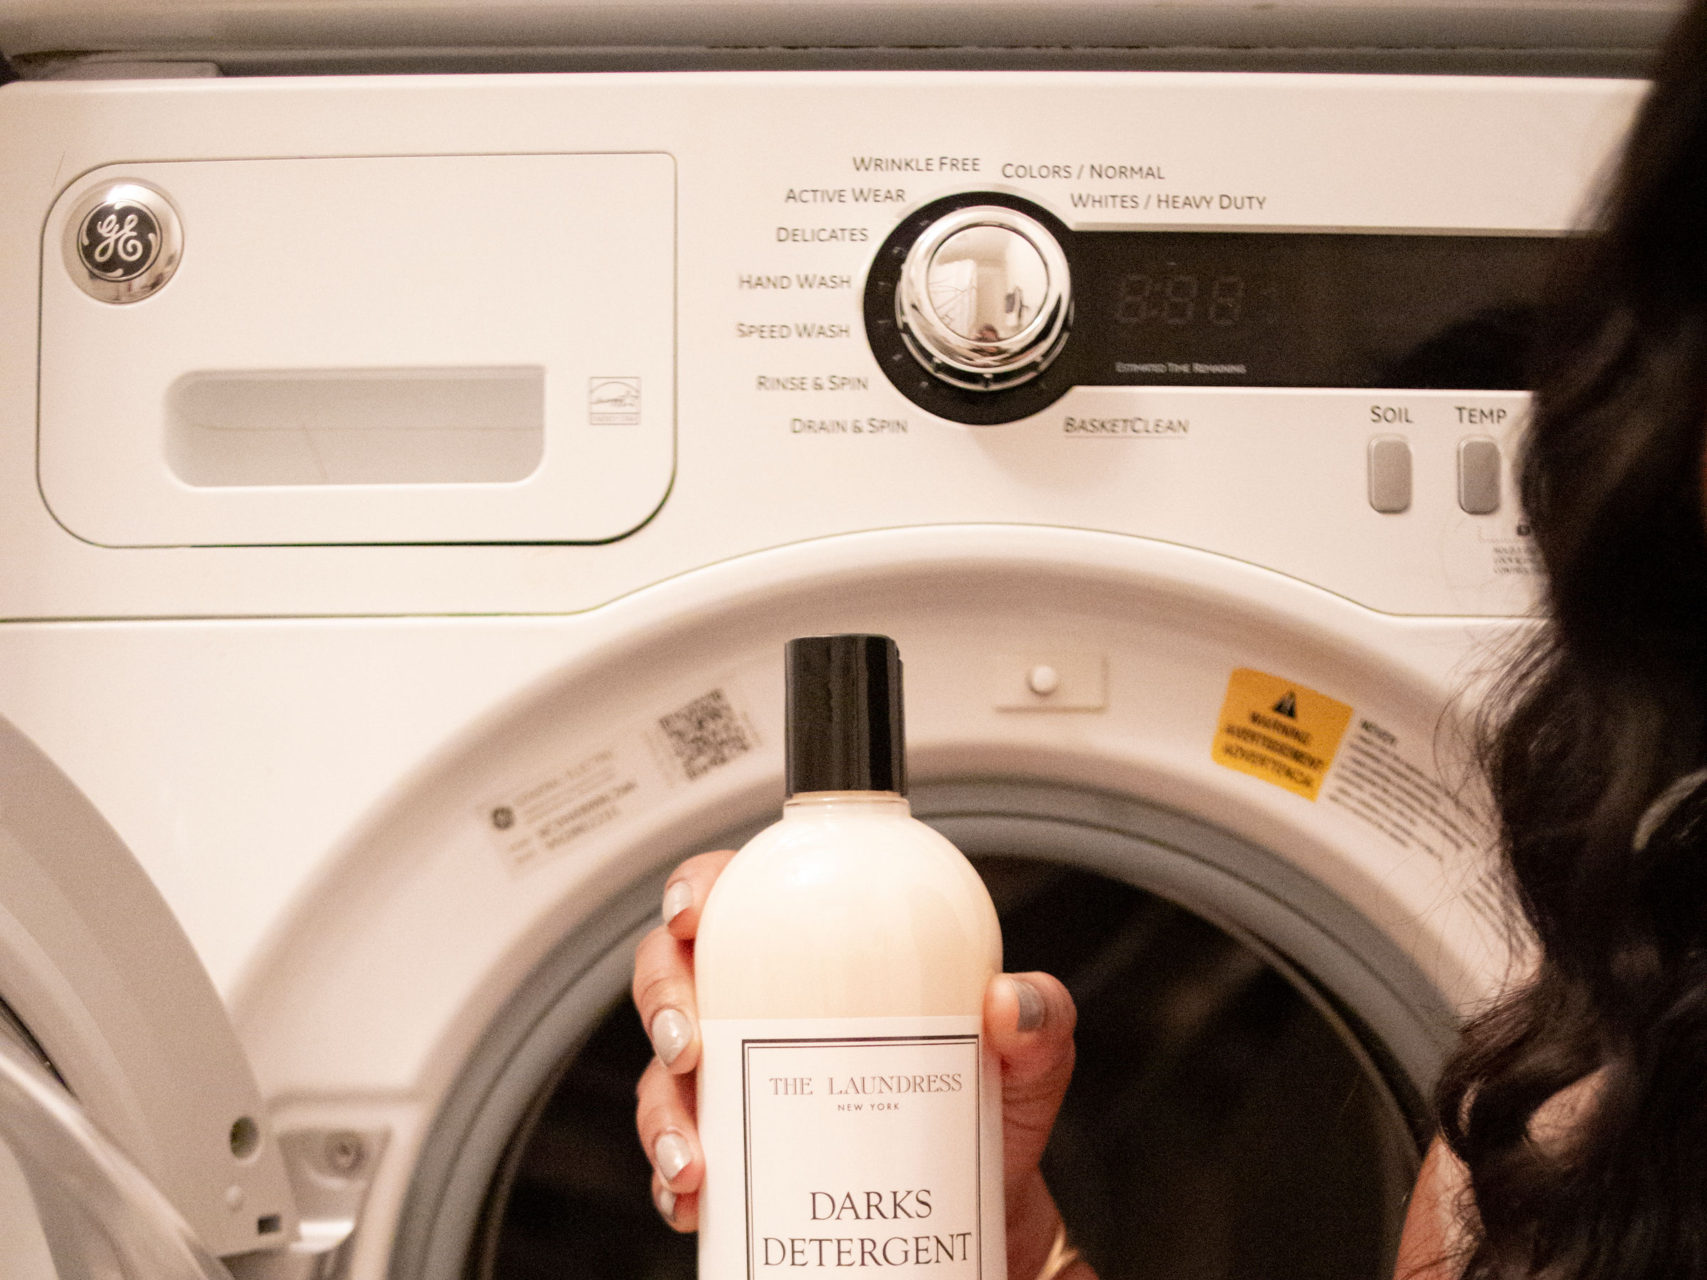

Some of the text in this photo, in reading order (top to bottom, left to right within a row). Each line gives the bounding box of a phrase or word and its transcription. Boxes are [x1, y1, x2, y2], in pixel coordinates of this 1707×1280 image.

[853, 156, 981, 172] WRINKLE FREE
[1001, 163, 1073, 179] COLORS
[1090, 164, 1166, 180] NORMAL
[785, 188, 906, 204] ACTIVE WEAR
[1070, 193, 1139, 209] WHITES
[1157, 194, 1213, 210] HEAVY
[1219, 194, 1267, 210] DUTY
[776, 227, 870, 243] DELICATES
[739, 274, 852, 290] HAND WASH
[736, 323, 850, 339] SPEED WASH
[757, 375, 869, 391] RINSE & SPIN
[1370, 405, 1507, 424] SOIL TEMP
[791, 418, 908, 434] DRAIN & SPIN
[1064, 416, 1190, 434] BASKETCLEAN
[769, 1073, 963, 1096] THE LAUNDRESS
[837, 1102, 900, 1112] NEW YORK
[810, 1189, 933, 1221] DARKS
[763, 1232, 972, 1267] DETERGENT
